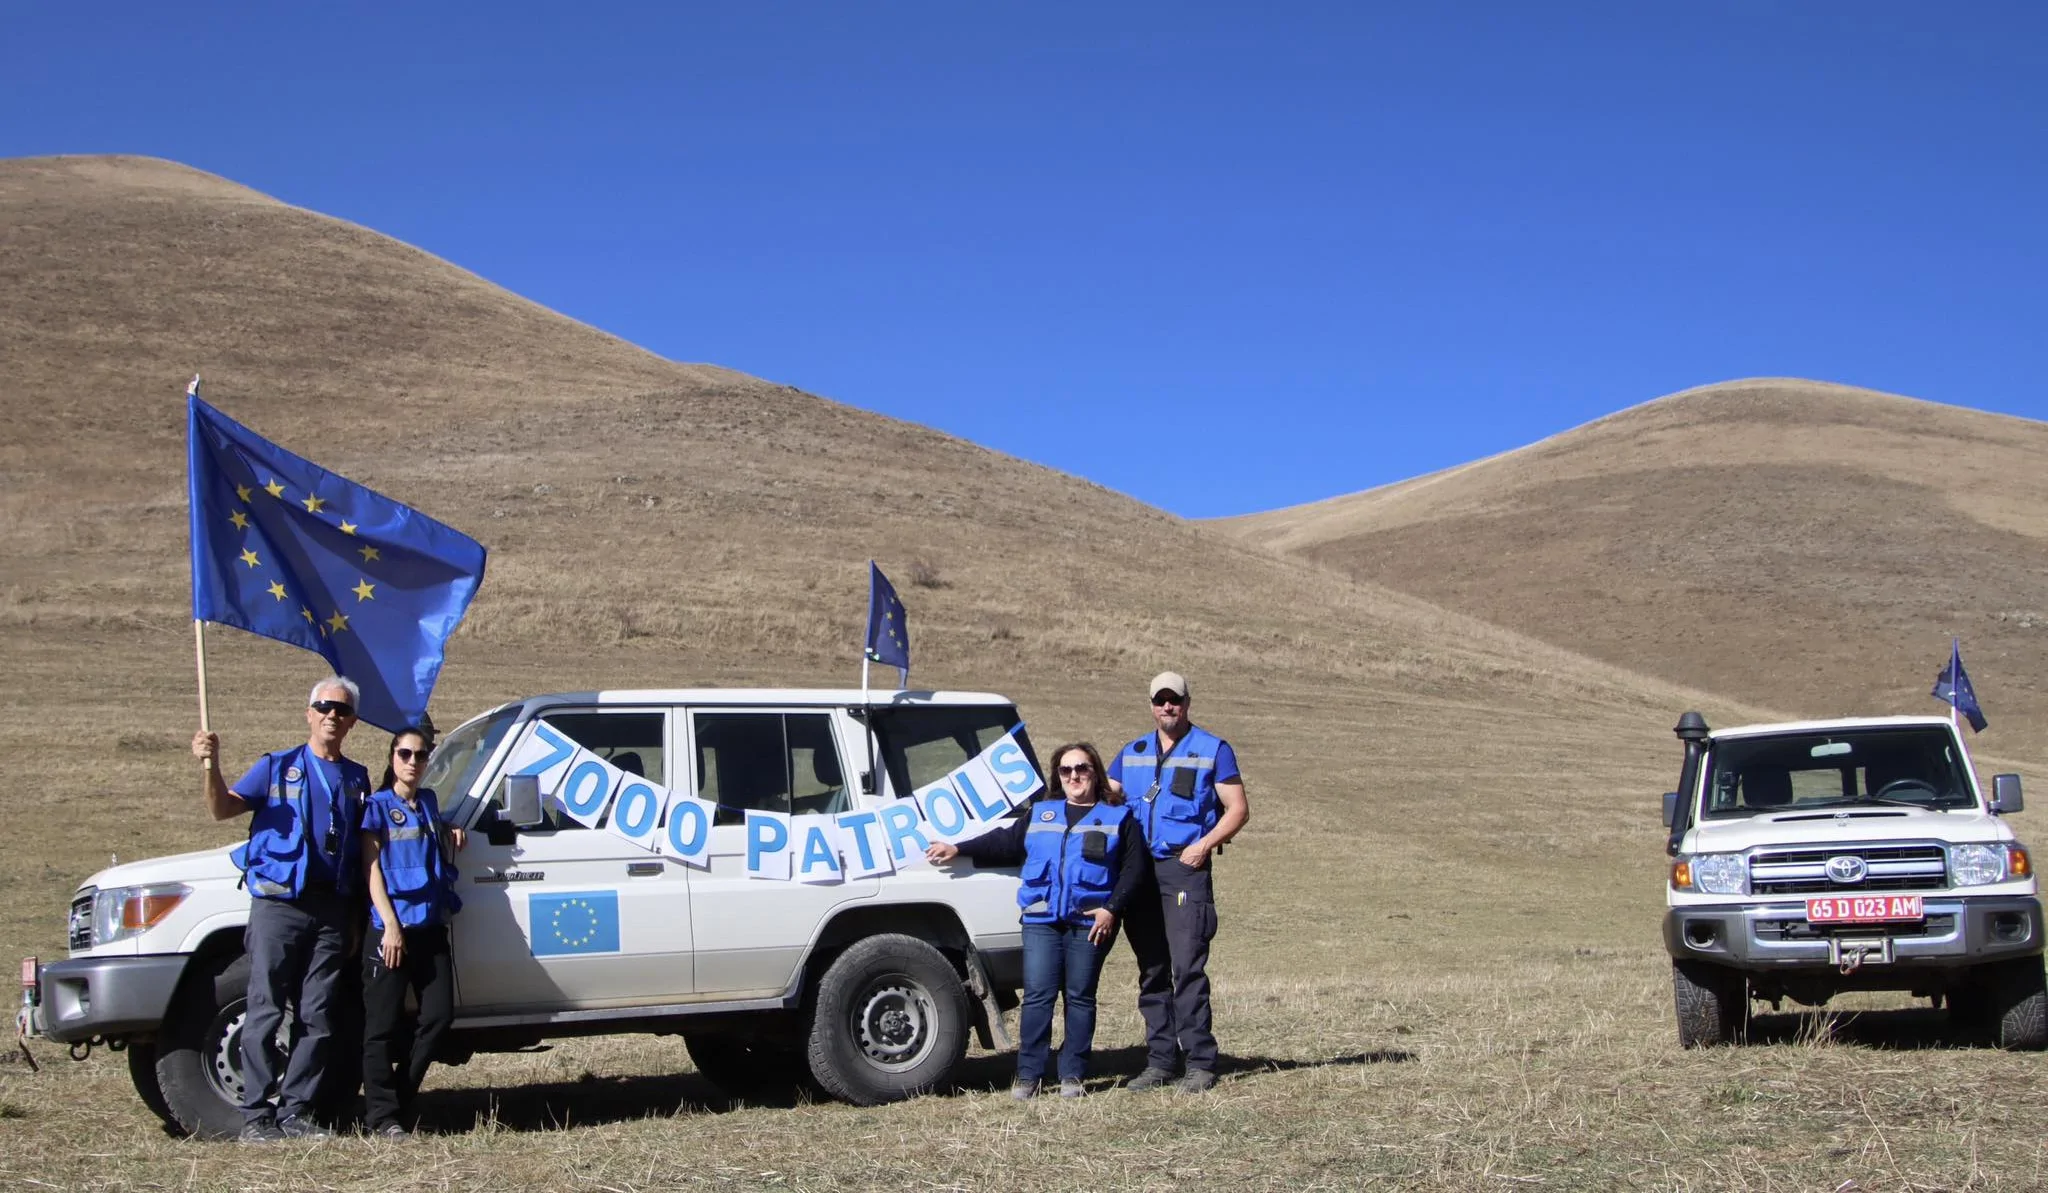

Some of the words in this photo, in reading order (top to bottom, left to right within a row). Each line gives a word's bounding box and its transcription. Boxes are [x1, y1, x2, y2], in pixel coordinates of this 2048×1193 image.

[515, 724, 708, 857] 7000
[747, 743, 1036, 873] PATROLS
[1812, 900, 1832, 918] 65
[1837, 899, 1850, 917] D
[1854, 898, 1886, 917] 023
[1891, 897, 1917, 916] AM
